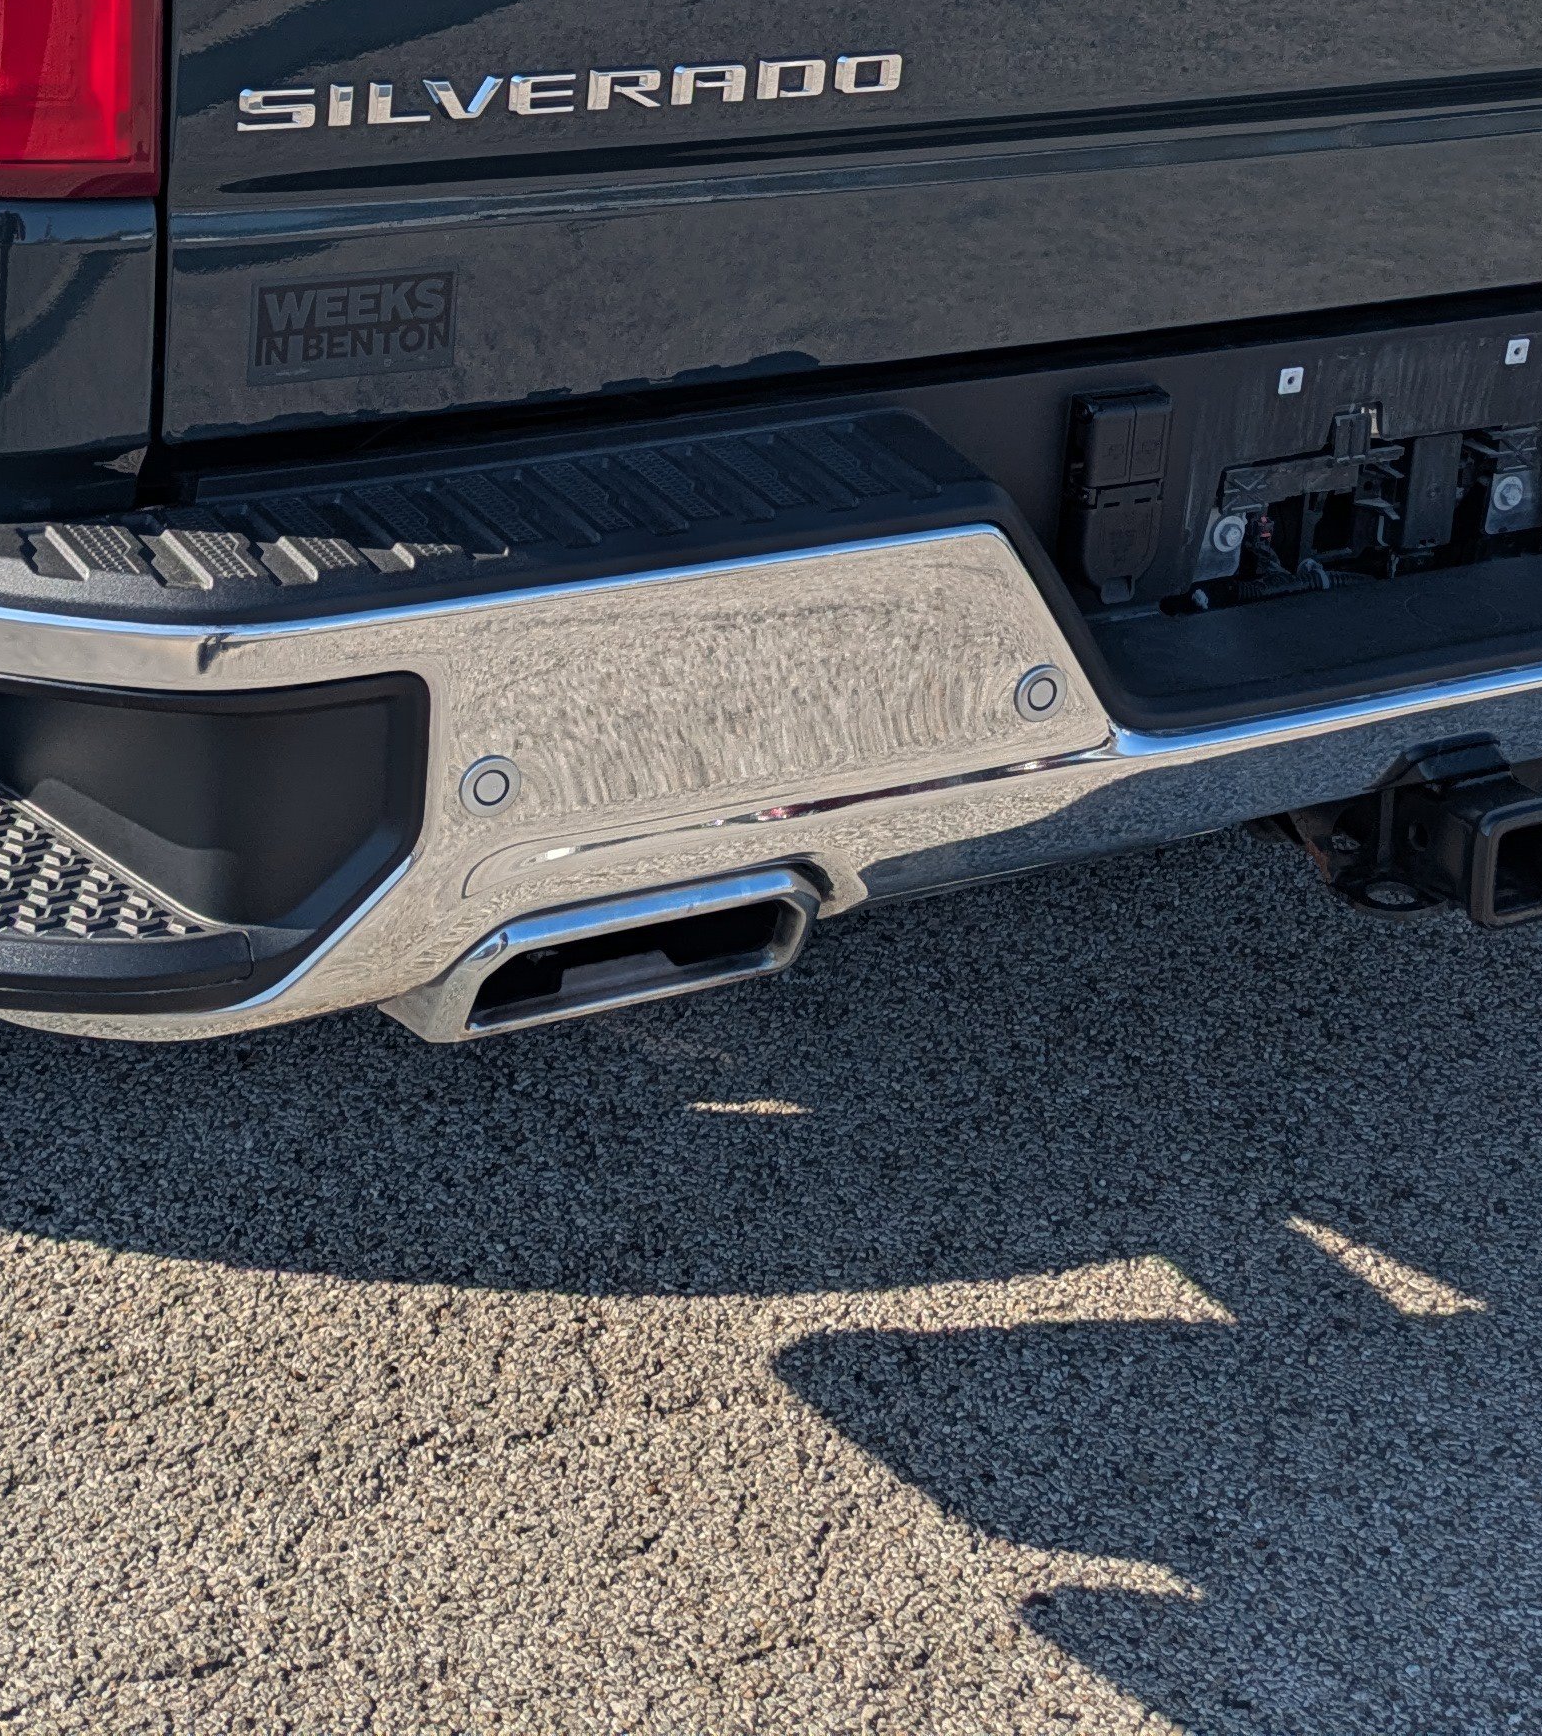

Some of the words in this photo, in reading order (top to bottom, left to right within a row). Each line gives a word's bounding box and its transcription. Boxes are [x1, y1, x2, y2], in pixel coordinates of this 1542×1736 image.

[236, 53, 902, 133] SILVERADO
[264, 278, 445, 331] WEEKS
[302, 321, 450, 362] BENTON
